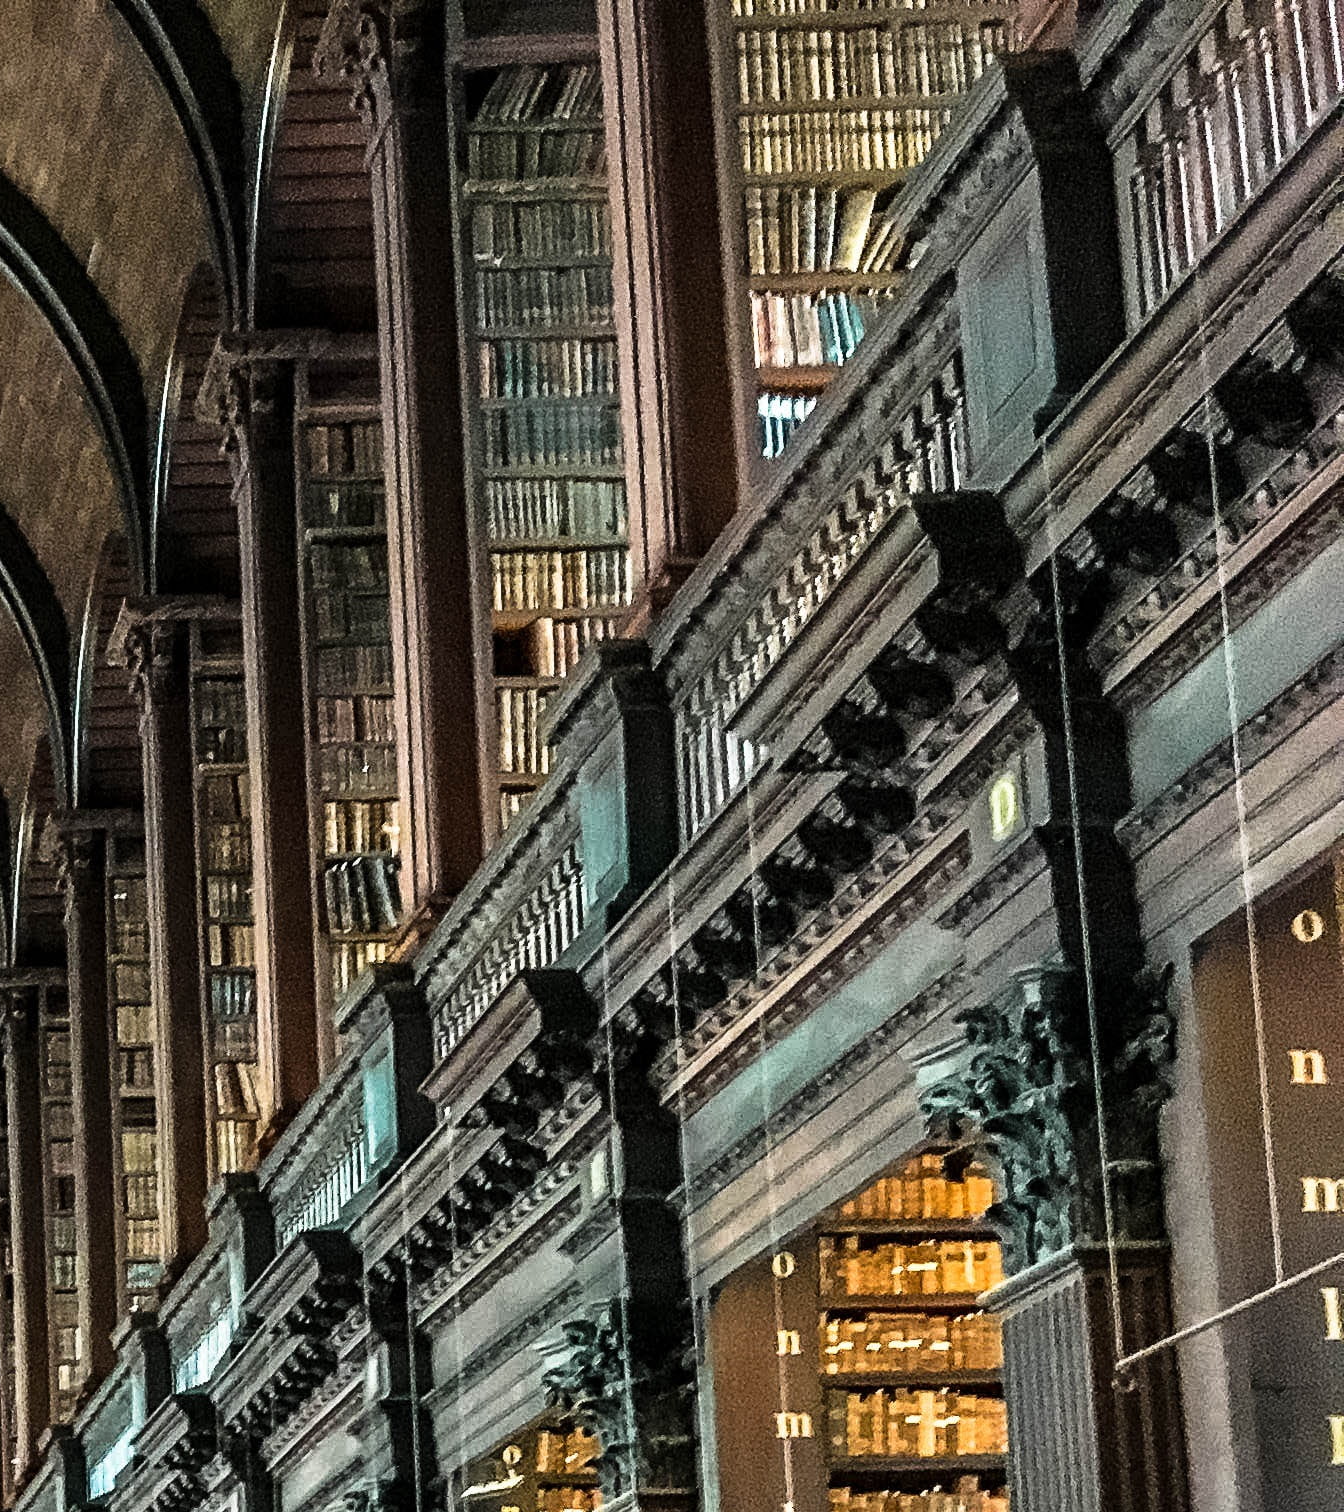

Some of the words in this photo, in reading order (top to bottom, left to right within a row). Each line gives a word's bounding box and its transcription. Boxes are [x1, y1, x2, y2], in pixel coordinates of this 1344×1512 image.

[1291, 909, 1325, 942] o
[1288, 1050, 1327, 1084] n
[772, 1252, 796, 1278] o
[1320, 1287, 1342, 1339] l
[777, 1330, 802, 1354] n
[775, 1413, 812, 1438] m
[502, 1445, 522, 1466] o
